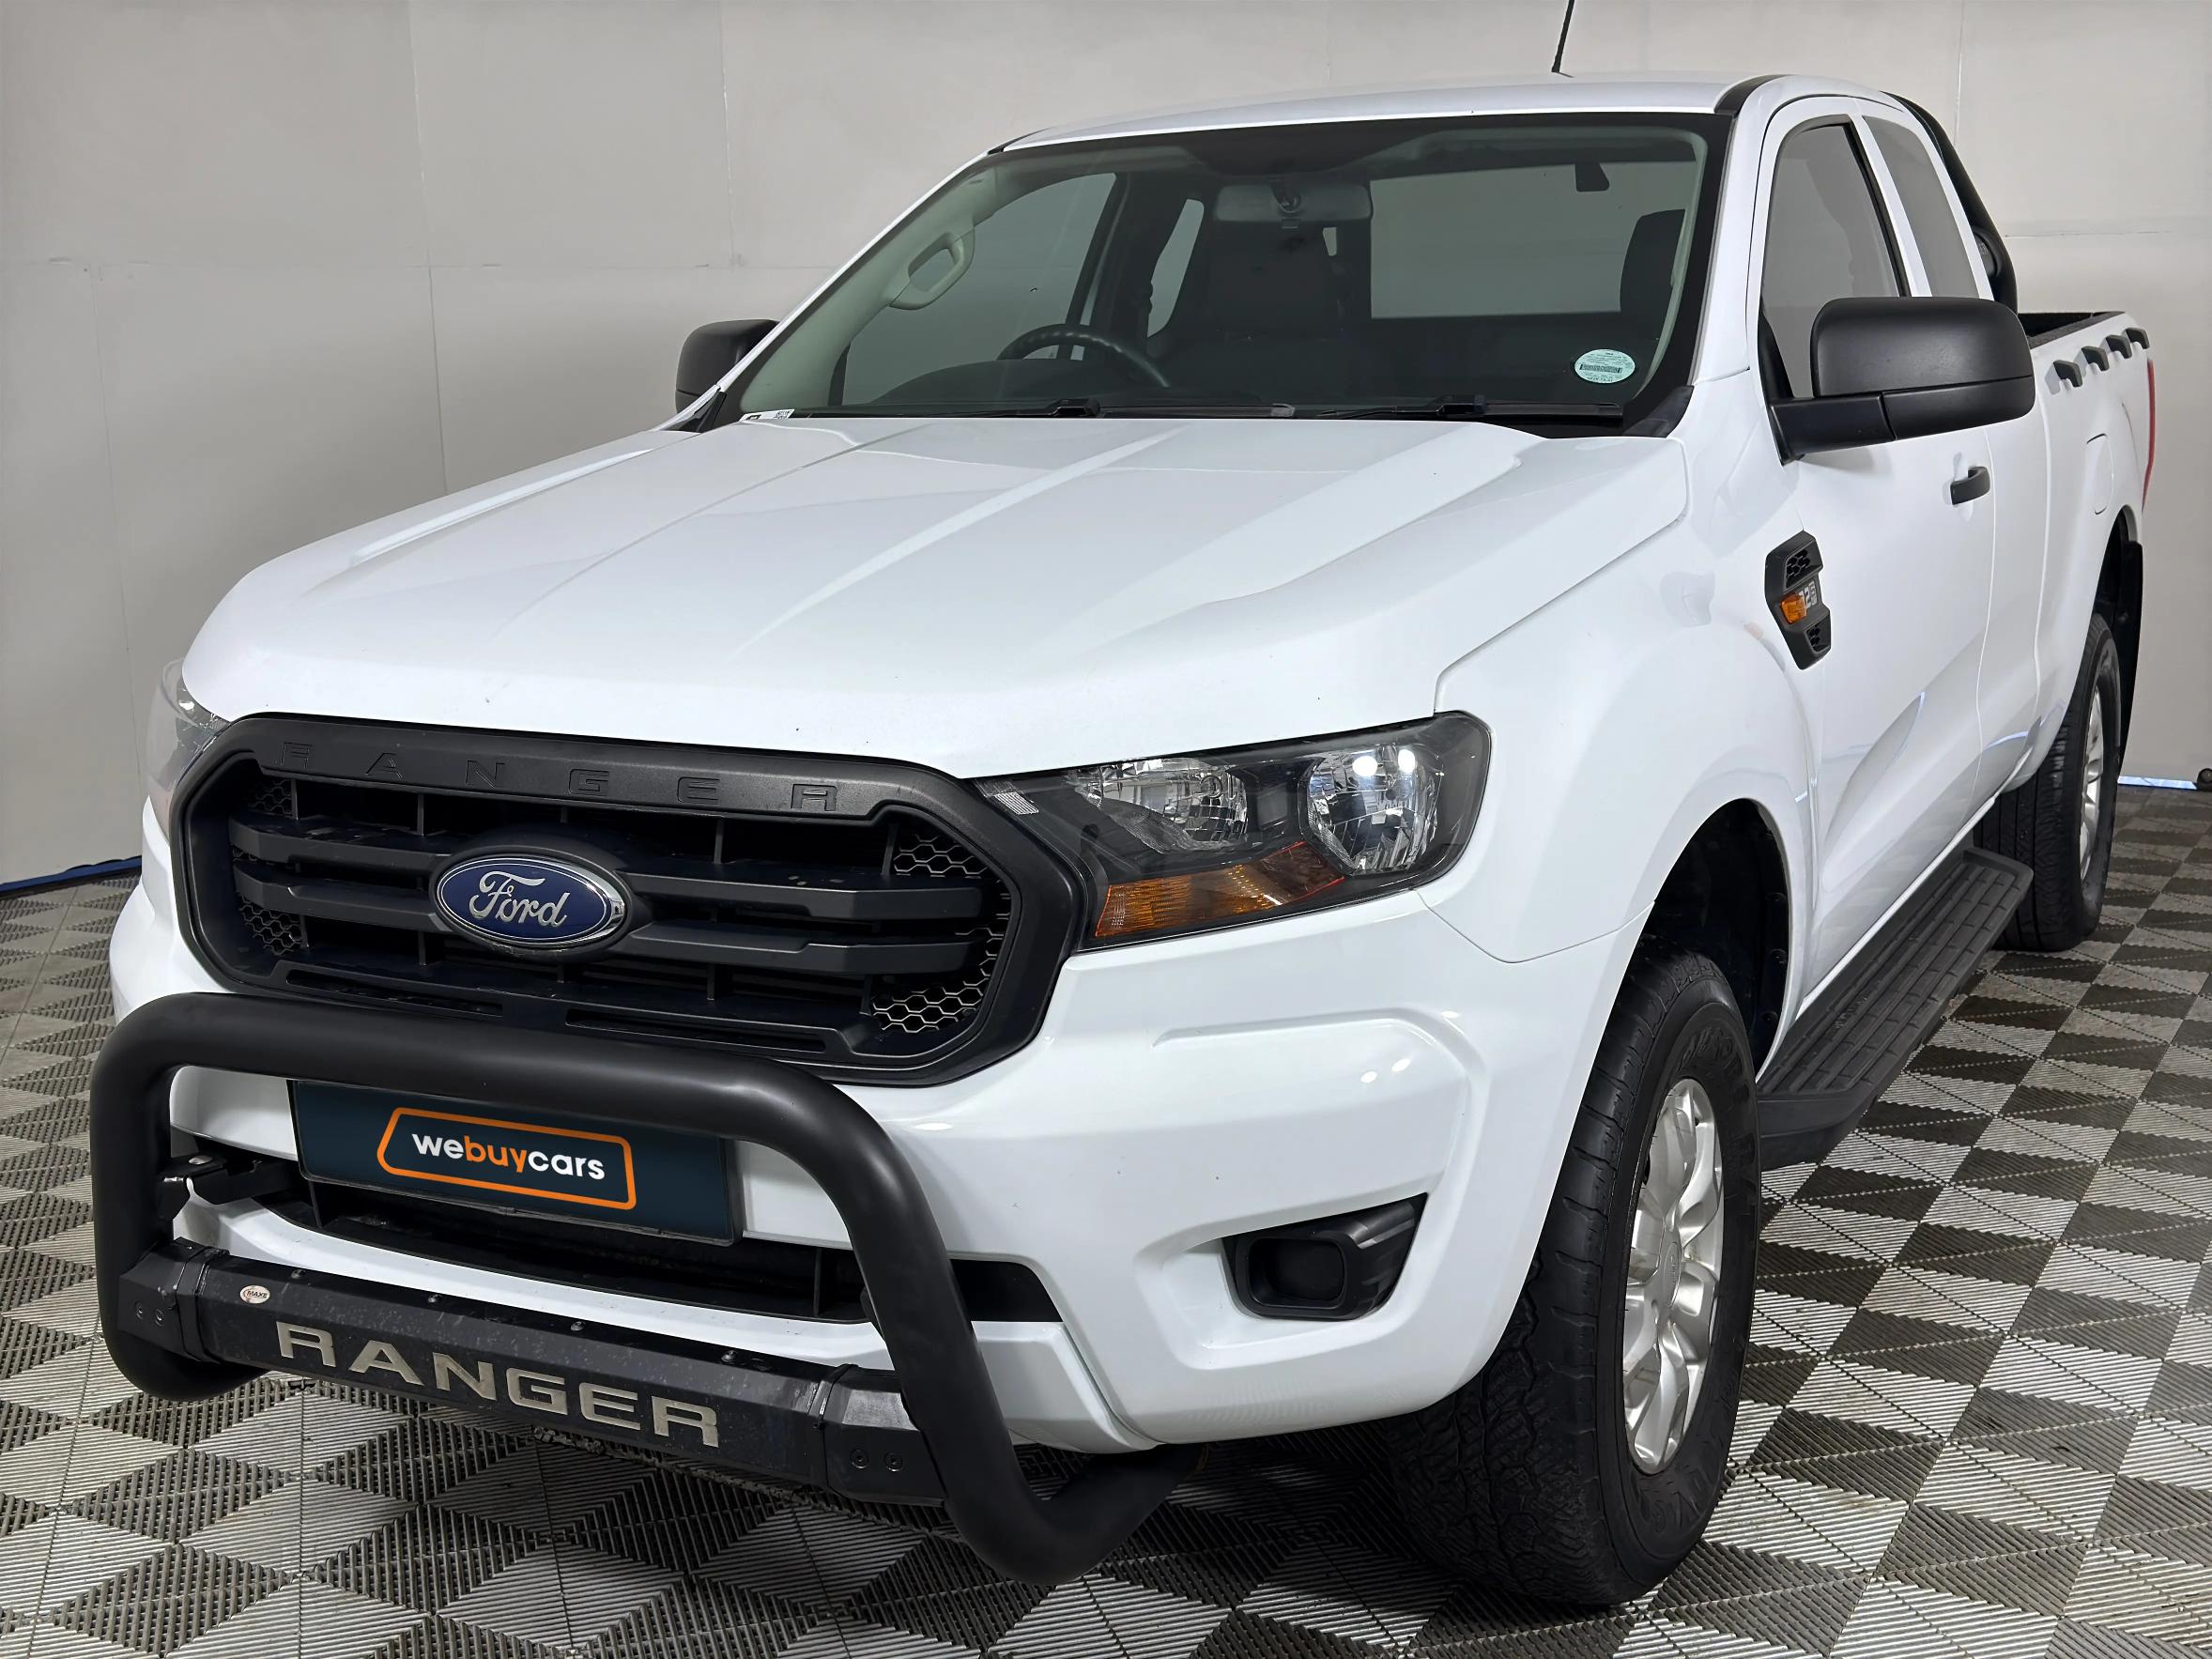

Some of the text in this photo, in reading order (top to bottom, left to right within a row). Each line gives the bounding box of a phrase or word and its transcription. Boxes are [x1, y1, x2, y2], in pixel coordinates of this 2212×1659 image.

[282, 741, 839, 812] RANGER
[469, 870, 571, 928] Ford
[411, 1132, 606, 1180] webuycars
[276, 1321, 719, 1448] RANGER
